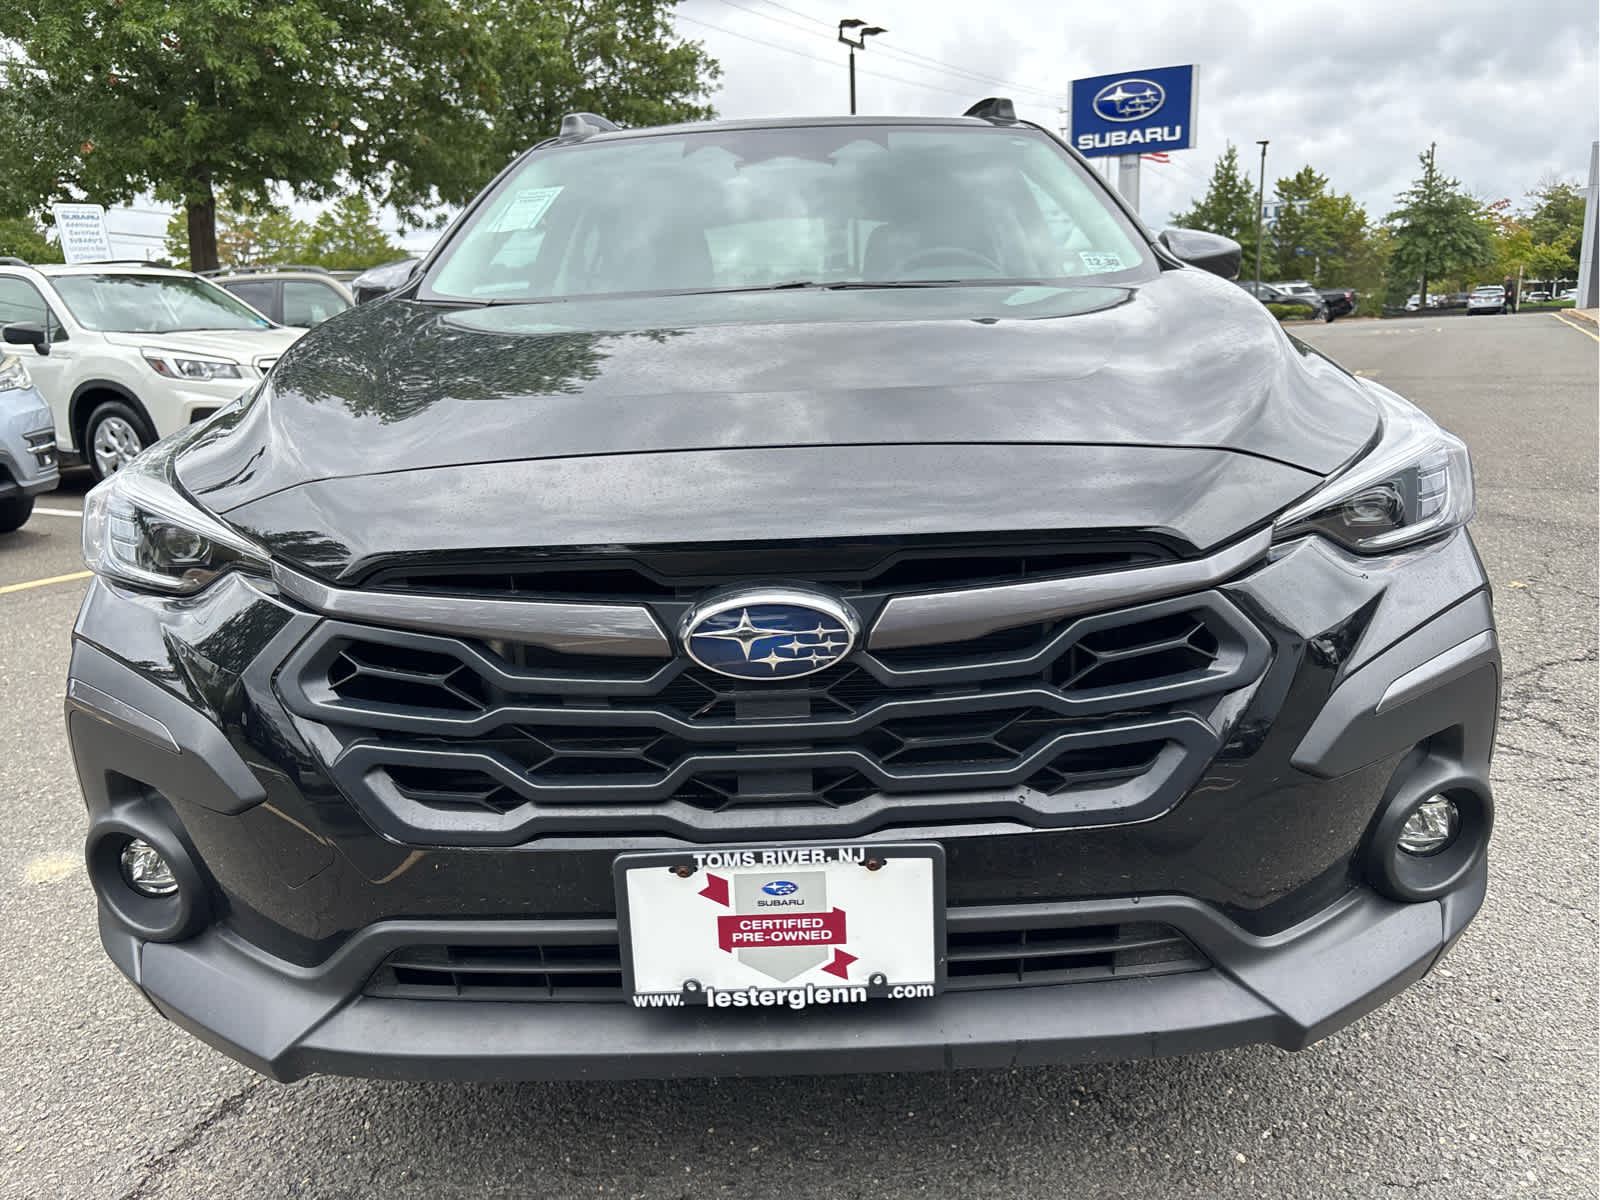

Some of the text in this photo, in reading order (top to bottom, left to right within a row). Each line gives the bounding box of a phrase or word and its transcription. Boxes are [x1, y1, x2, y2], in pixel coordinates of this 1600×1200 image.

[1077, 125, 1182, 150] SUBARU
[693, 847, 866, 869] TOMS RIVER, NJ
[757, 898, 805, 908] SUBARU
[739, 918, 824, 931] CERTIFIED
[732, 930, 833, 943] PRE-OWNED
[633, 984, 935, 1009] www. lesterglenn .com
